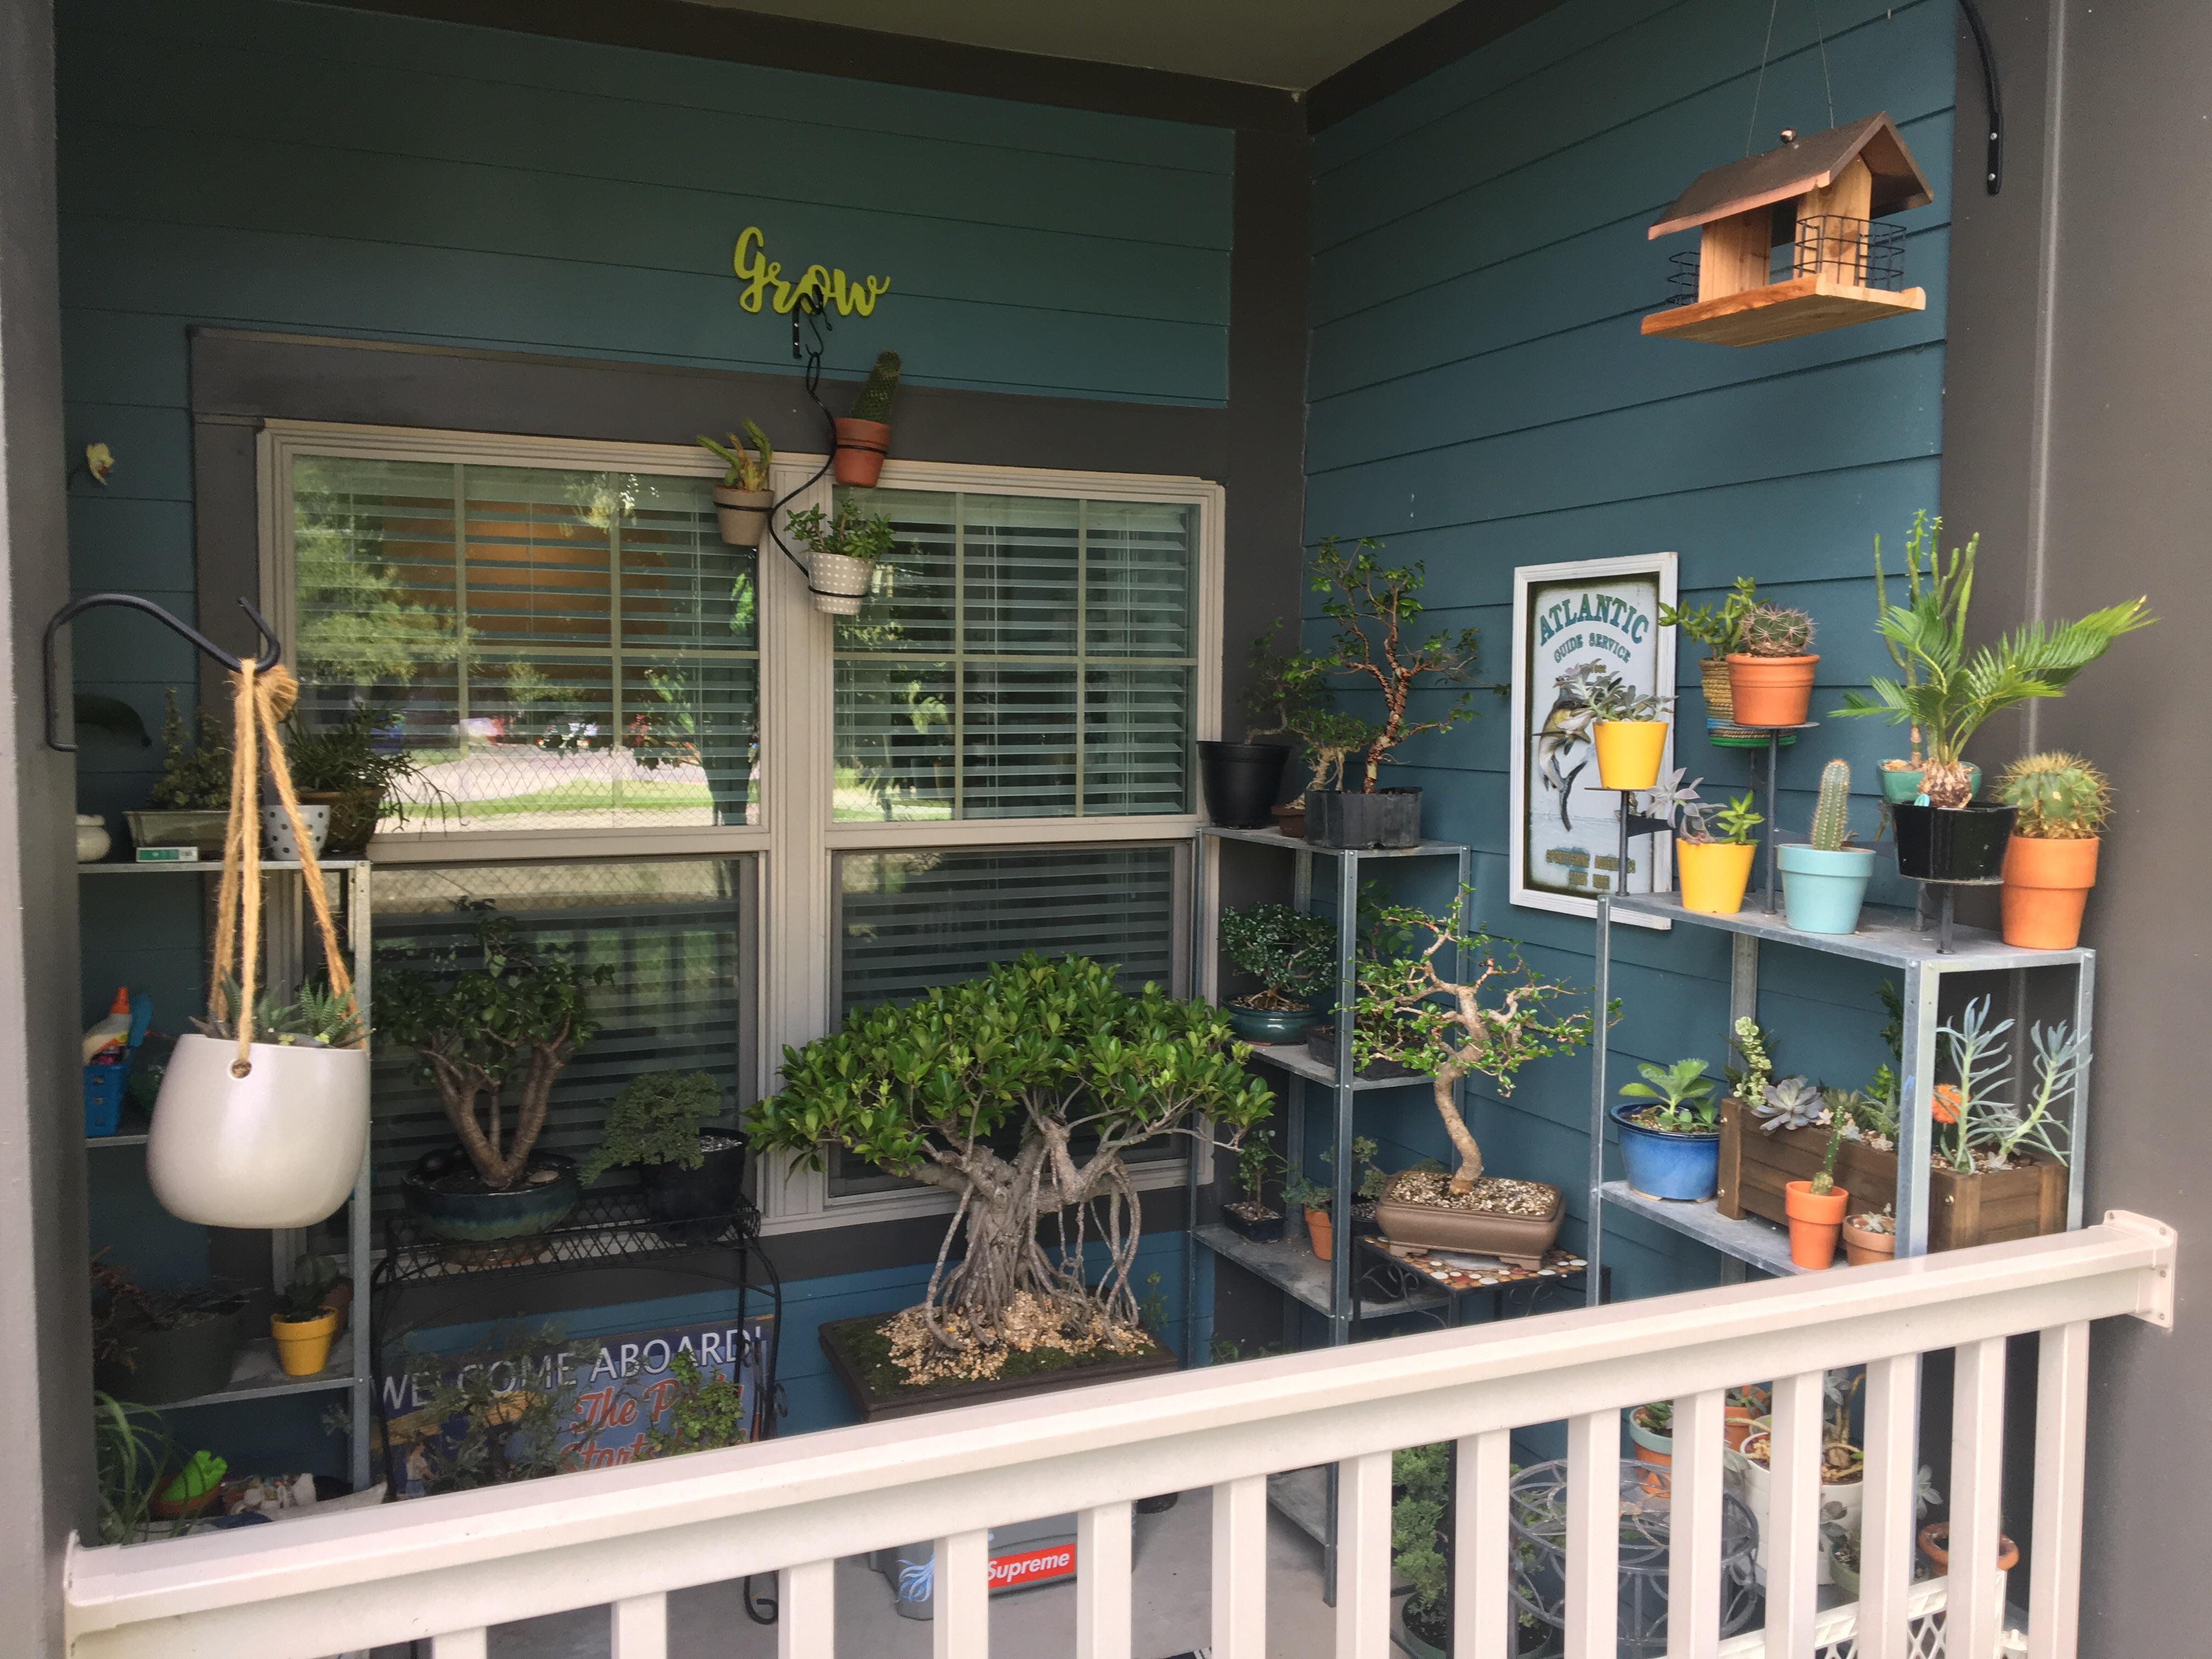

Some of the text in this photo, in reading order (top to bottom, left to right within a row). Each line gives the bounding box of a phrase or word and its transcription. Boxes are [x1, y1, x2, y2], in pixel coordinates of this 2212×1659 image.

[733, 226, 891, 317] Grow
[1540, 593, 1649, 647] ATLANTIC
[1554, 632, 1632, 664] GUIDE SERVICE
[369, 1352, 577, 1409] WECOME
[569, 1385, 639, 1435] The
[988, 1553, 1070, 1582] Supreme
